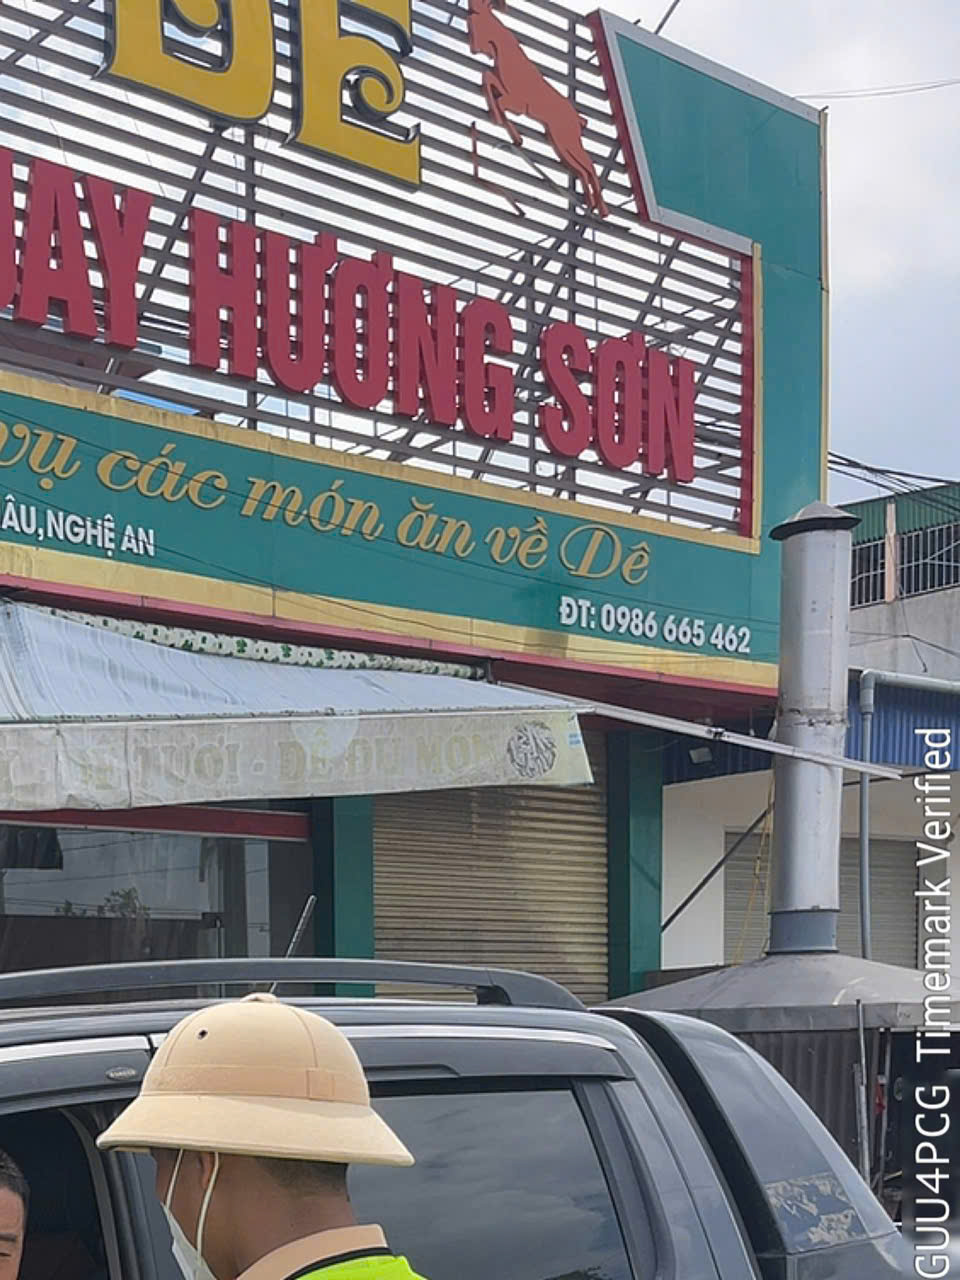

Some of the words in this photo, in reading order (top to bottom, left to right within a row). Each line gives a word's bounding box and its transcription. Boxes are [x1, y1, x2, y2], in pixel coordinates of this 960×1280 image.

[188, 209, 515, 443] HƯƠNG
[539, 320, 696, 485] SƠN
[96, 443, 231, 510] các
[240, 479, 385, 541] món
[395, 496, 479, 560] ăn
[484, 517, 550, 571] về
[559, 522, 652, 586] Dê
[120, 525, 156, 557] AN
[559, 595, 596, 630] ĐT:
[600, 602, 659, 639] 0986
[663, 614, 706, 647] 665
[709, 622, 751, 654] 462
